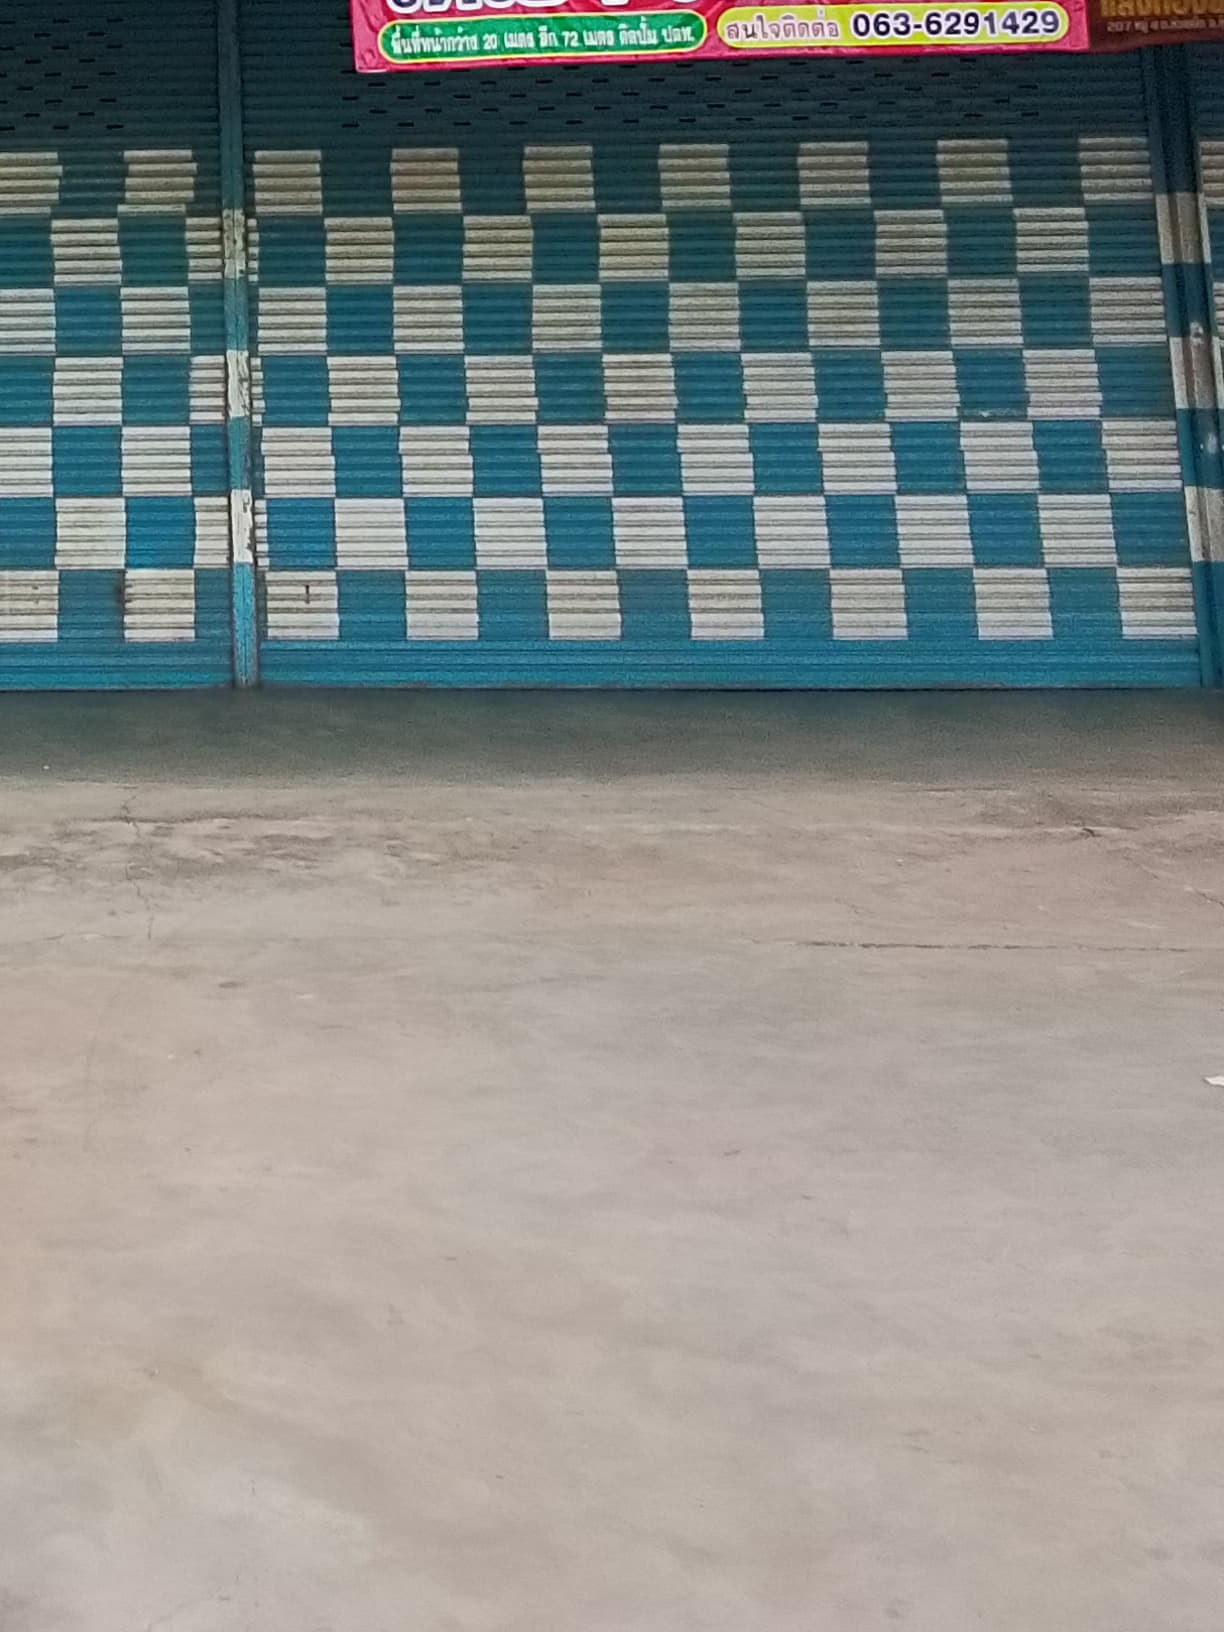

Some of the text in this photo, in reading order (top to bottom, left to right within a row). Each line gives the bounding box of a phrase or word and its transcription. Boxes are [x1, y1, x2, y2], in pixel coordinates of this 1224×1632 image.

[725, 8, 1061, 42] สนใจติดต่อ 063-6291429
[482, 33, 498, 51] 20
[562, 31, 579, 47] 72
